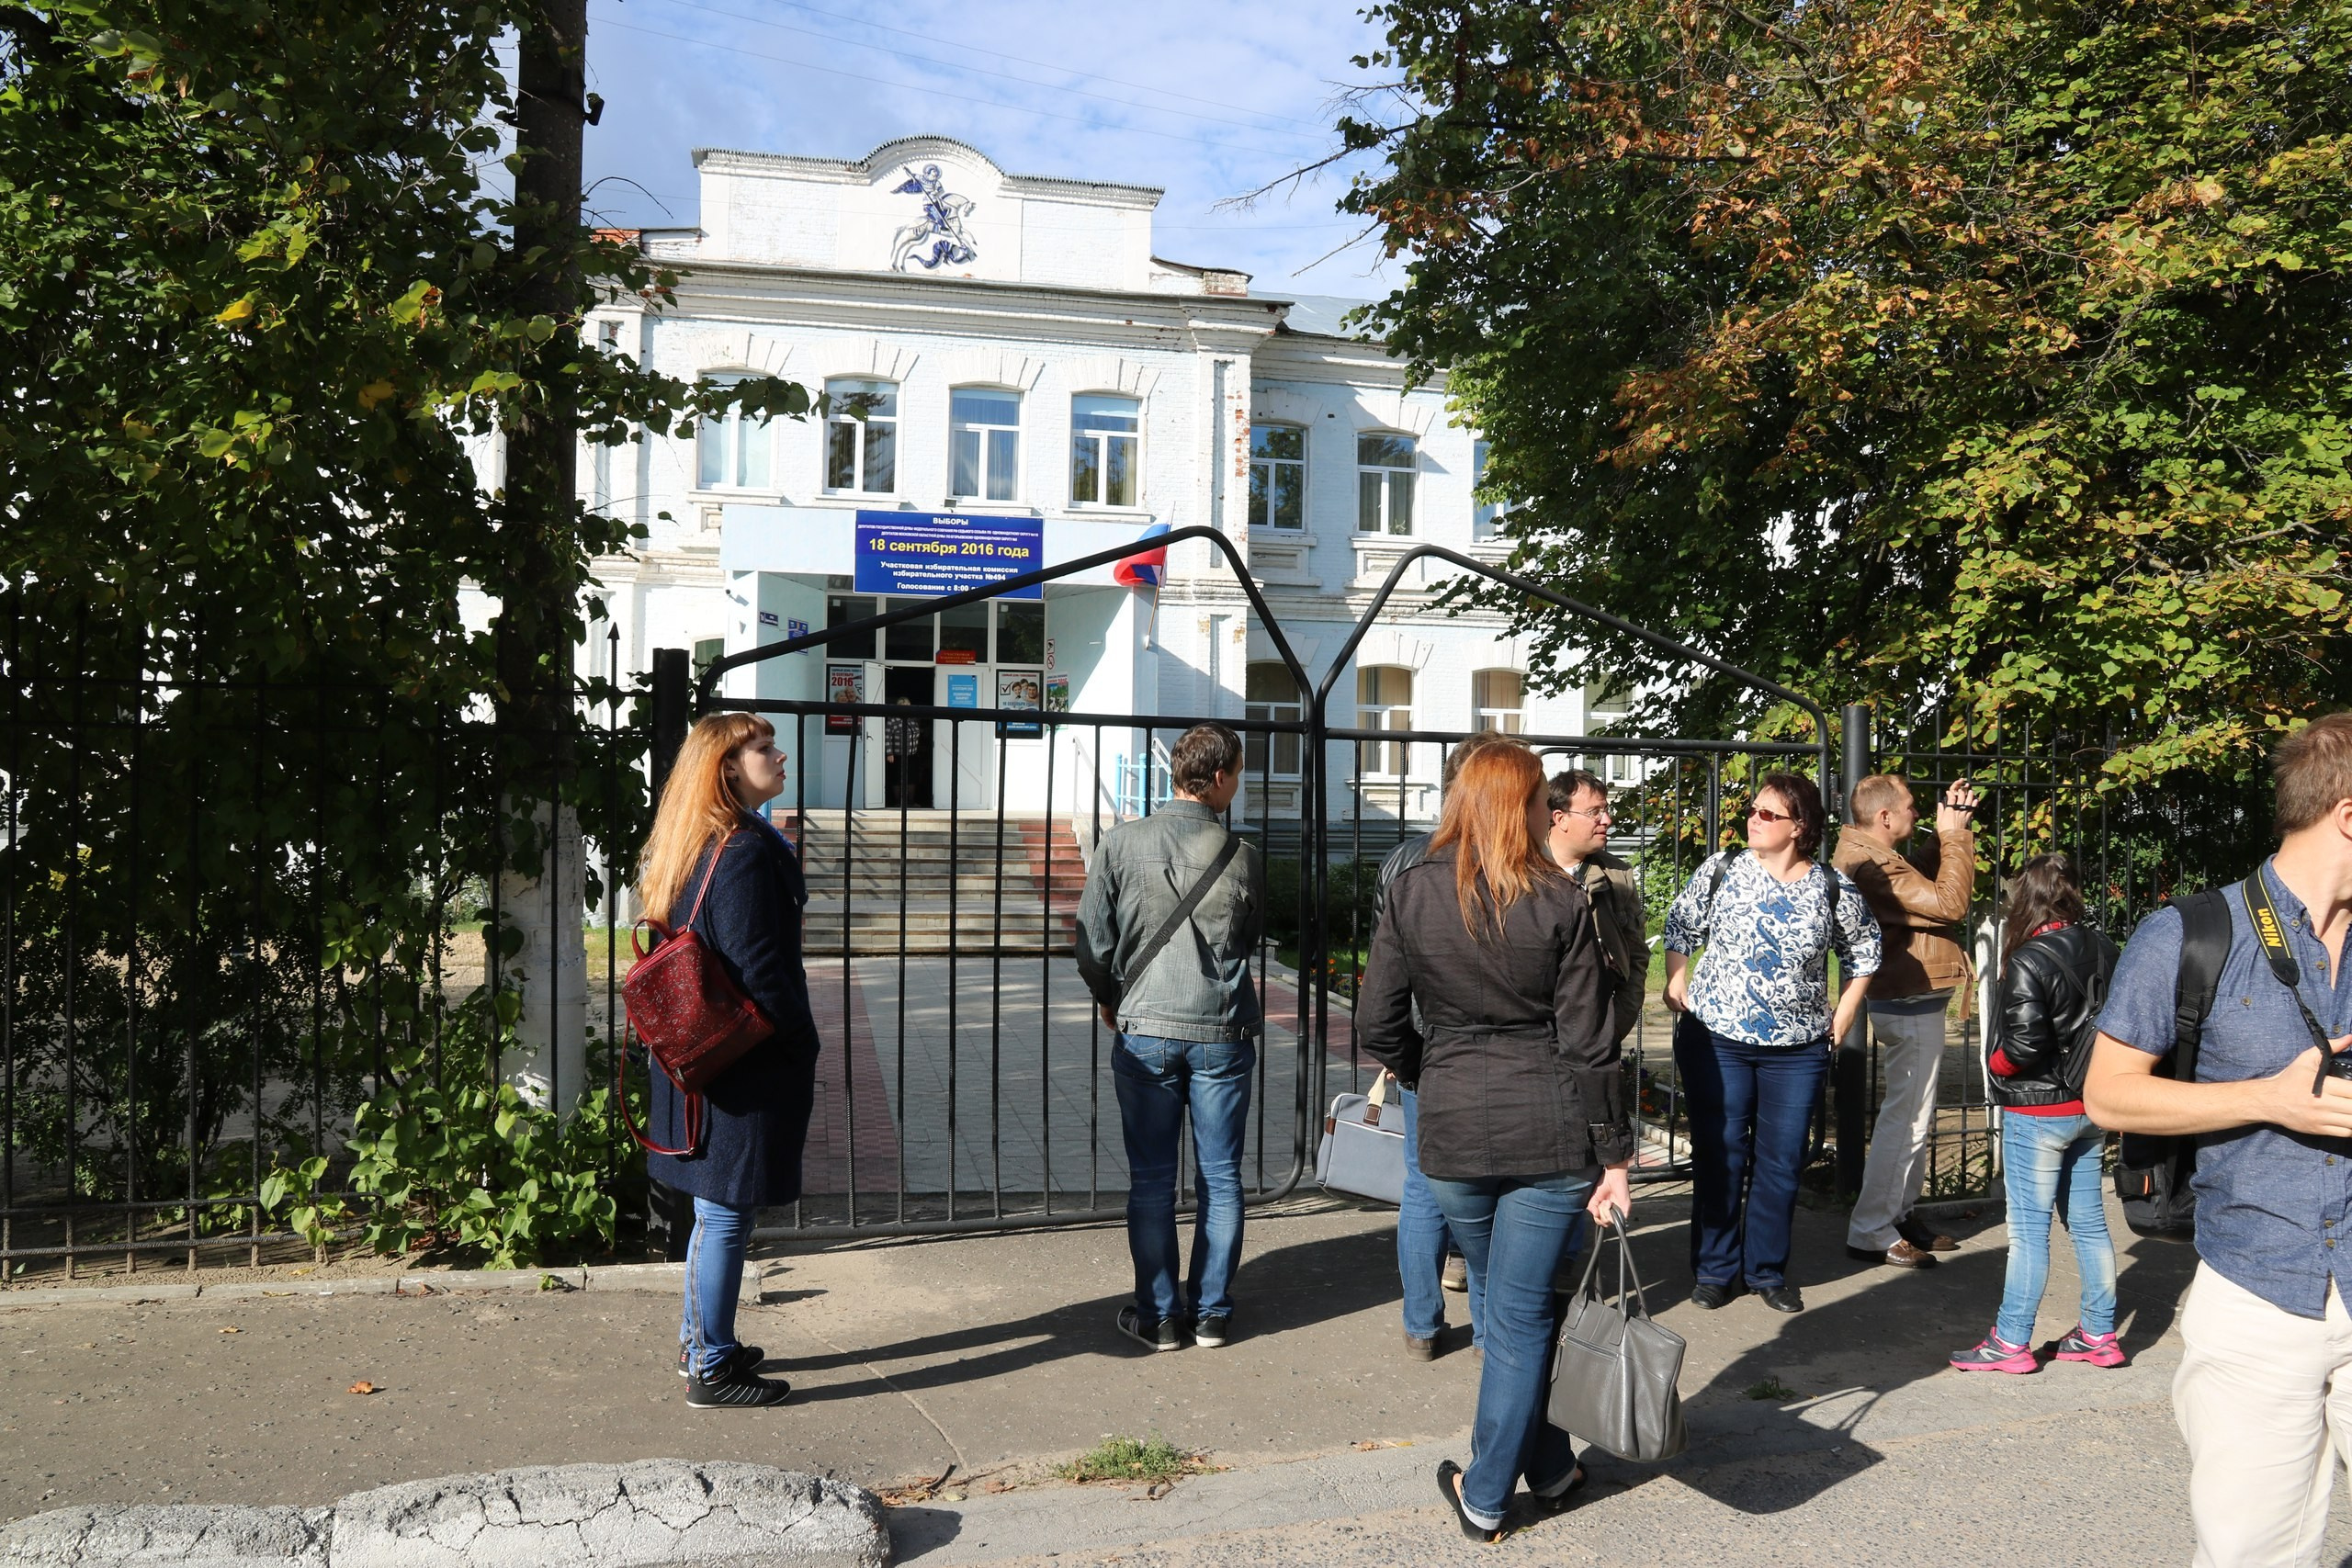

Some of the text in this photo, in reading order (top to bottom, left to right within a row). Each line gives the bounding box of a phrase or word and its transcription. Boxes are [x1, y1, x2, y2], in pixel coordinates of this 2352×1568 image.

[933, 517, 968, 525] ВЫБОРЫ
[869, 538, 1029, 558] 18 сентября 2016 года
[880, 561, 923, 570] Участковая
[925, 563, 981, 572] избирательная
[893, 570, 953, 579] избирательного
[897, 582, 945, 591] Голосование
[831, 676, 854, 687] 2016
[2257, 908, 2282, 947] Nikon
